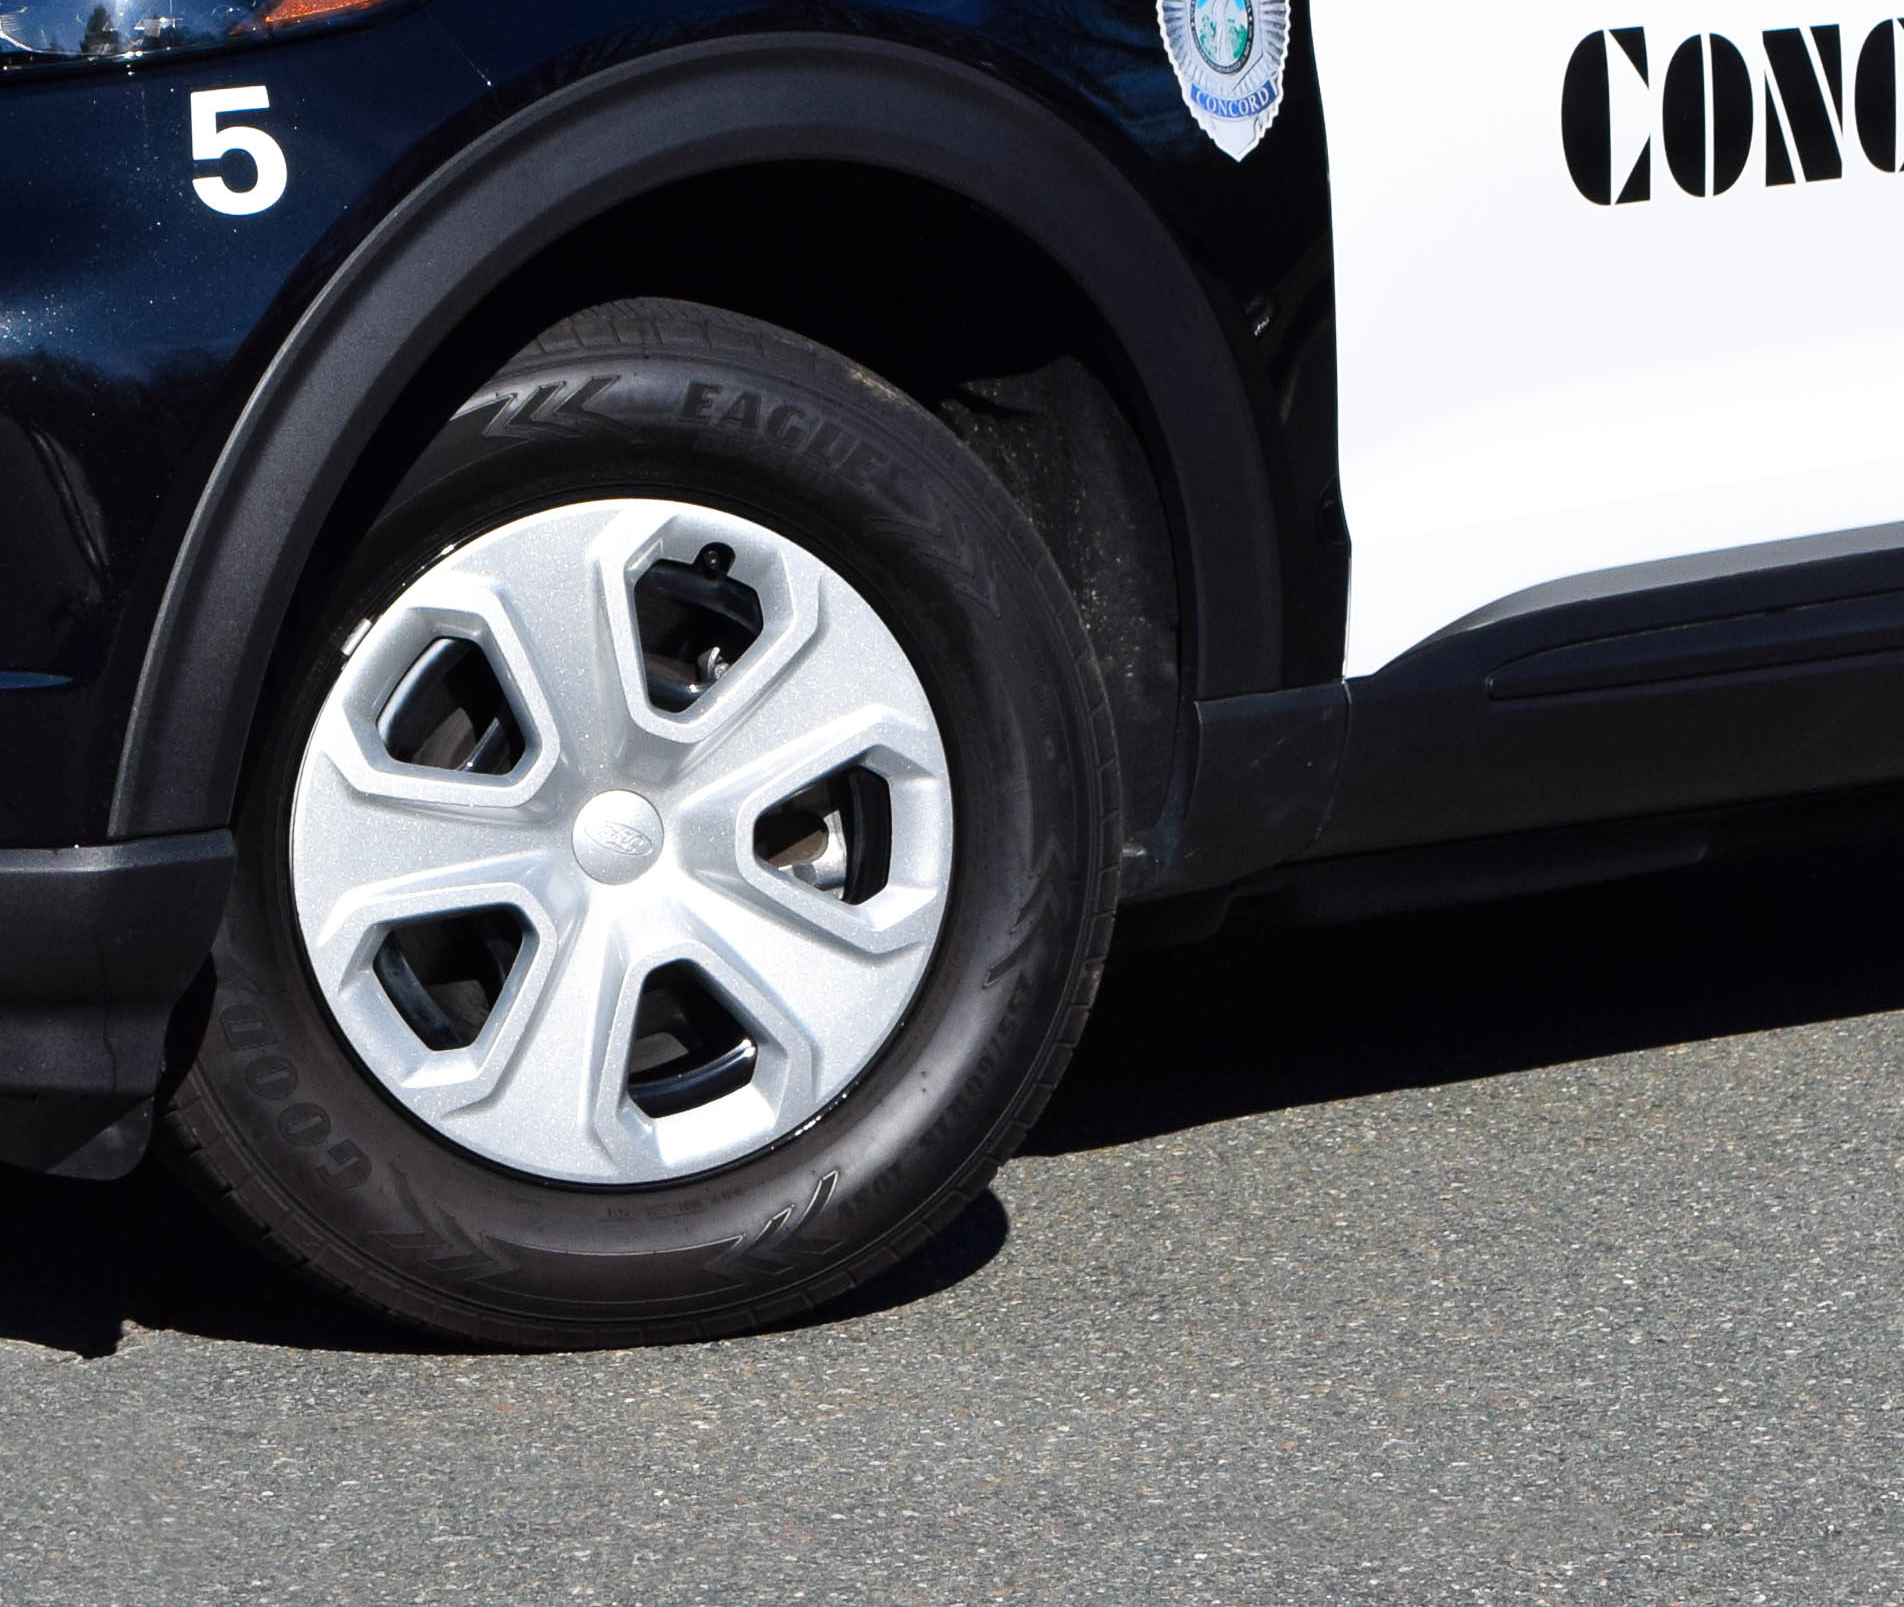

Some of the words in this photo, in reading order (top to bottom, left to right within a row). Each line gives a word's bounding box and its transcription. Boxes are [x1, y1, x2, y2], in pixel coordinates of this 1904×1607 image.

[190, 84, 288, 217] 5
[1196, 86, 1270, 117] CONCORD
[679, 380, 893, 482] EAGLE
